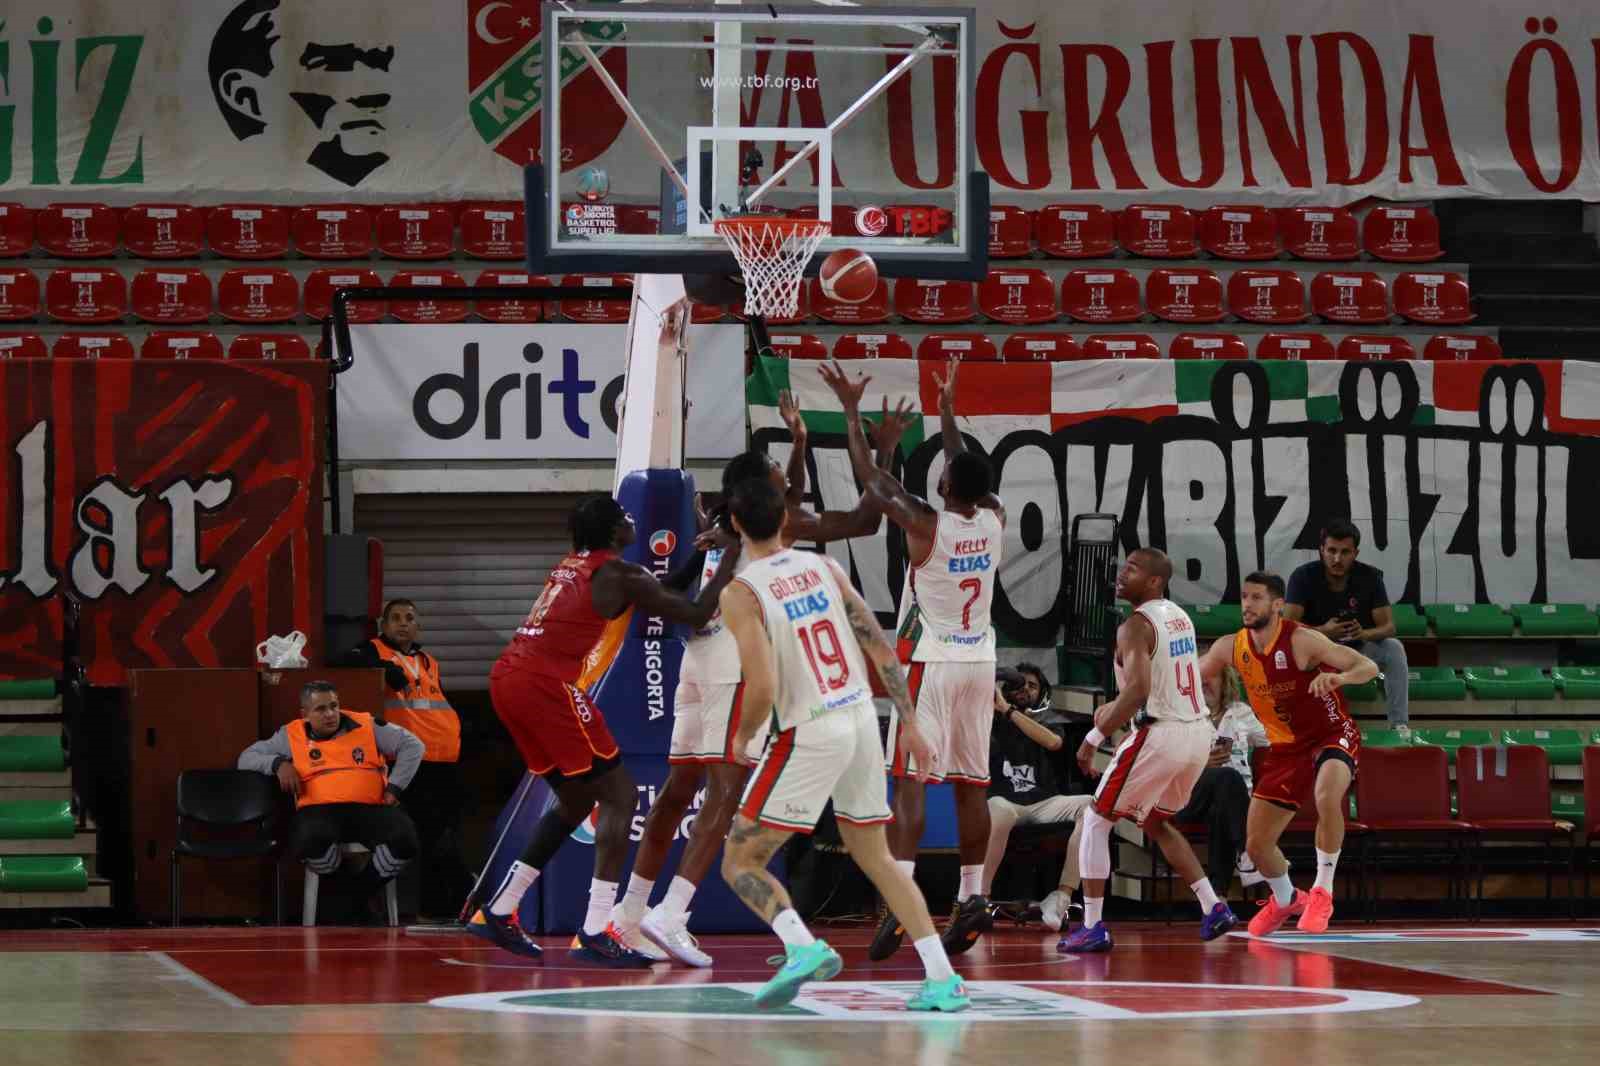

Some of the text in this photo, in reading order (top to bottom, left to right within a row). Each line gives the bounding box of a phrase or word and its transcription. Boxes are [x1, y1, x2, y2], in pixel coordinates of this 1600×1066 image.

[0, 16, 144, 185] İZ
[700, 74, 820, 91] www.tbf.org.tr
[881, 19, 1470, 190] UĞRUNDA
[1505, 16, 1600, 193] Ö
[889, 207, 951, 234] TBF
[0, 420, 232, 599] lar
[955, 537, 988, 555] KELLY
[959, 577, 981, 631] 7
[797, 619, 850, 694] 19
[1175, 660, 1201, 714] 4
